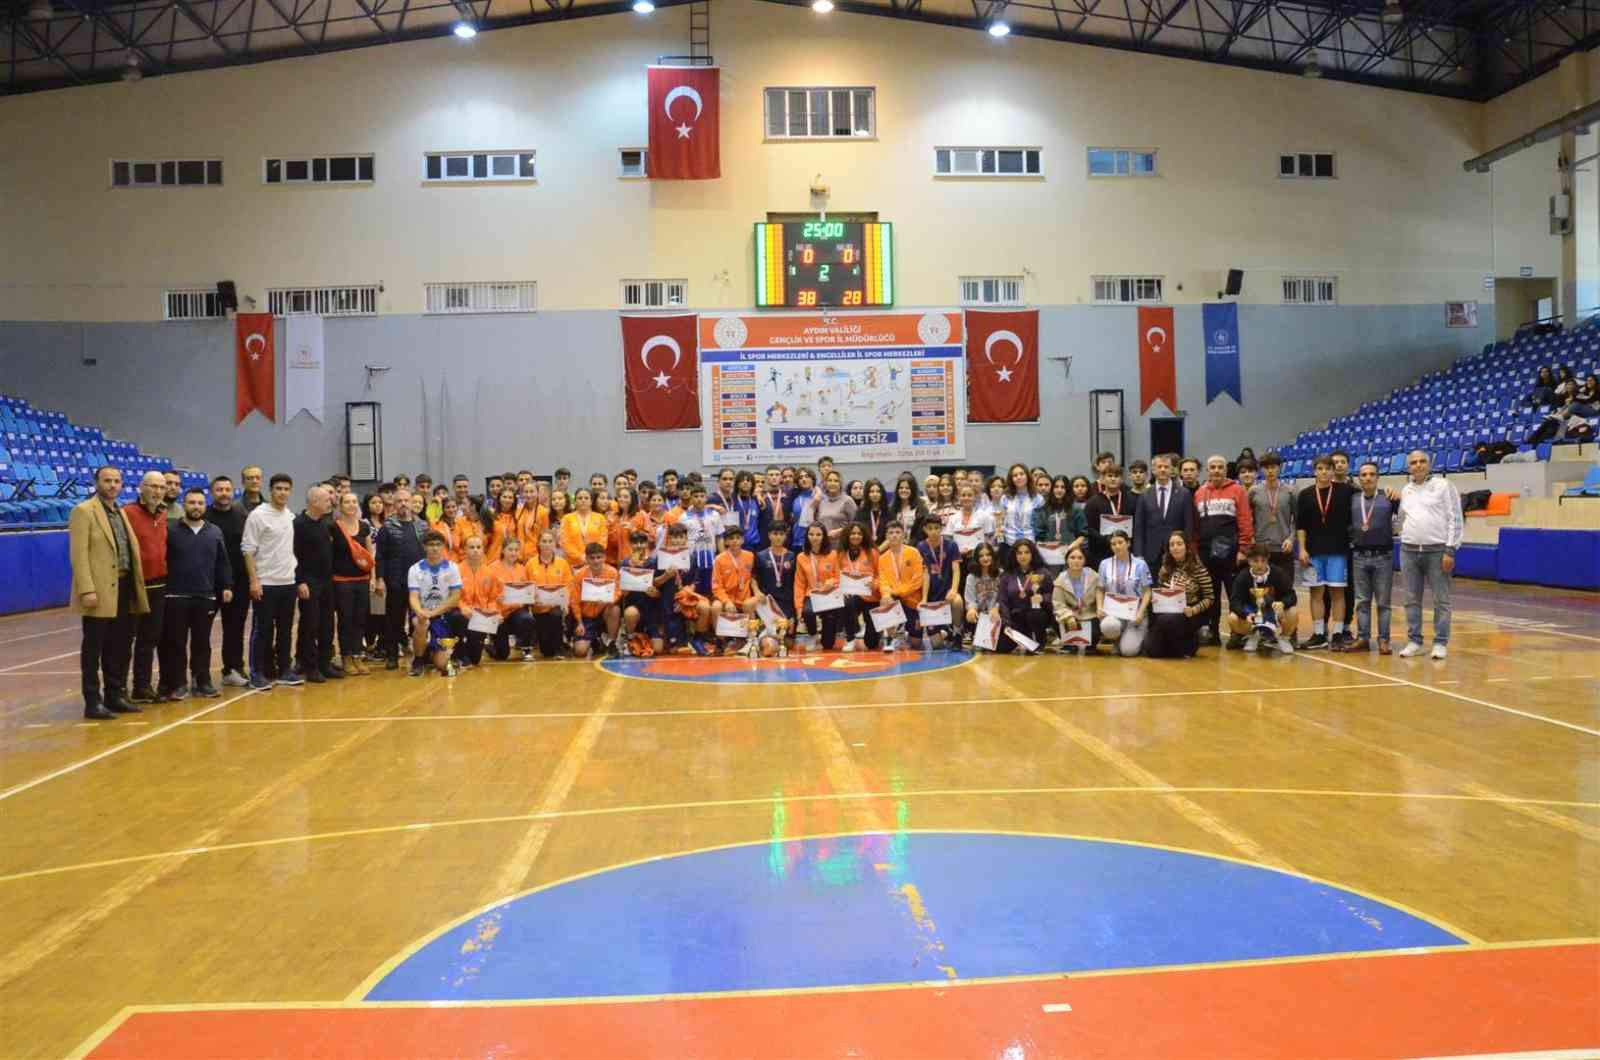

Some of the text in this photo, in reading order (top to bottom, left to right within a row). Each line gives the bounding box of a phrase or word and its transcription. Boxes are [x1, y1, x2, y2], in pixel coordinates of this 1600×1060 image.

[803, 222, 843, 237] 25:00
[803, 249, 813, 263] 0
[844, 249, 853, 263] 0
[820, 264, 829, 279] 2
[798, 291, 816, 305] 38
[843, 291, 862, 304] 28
[803, 335, 814, 343] VE
[815, 335, 835, 344] SPOR
[783, 431, 888, 447] 5-18 YAŞ ÜCRETSİZ
